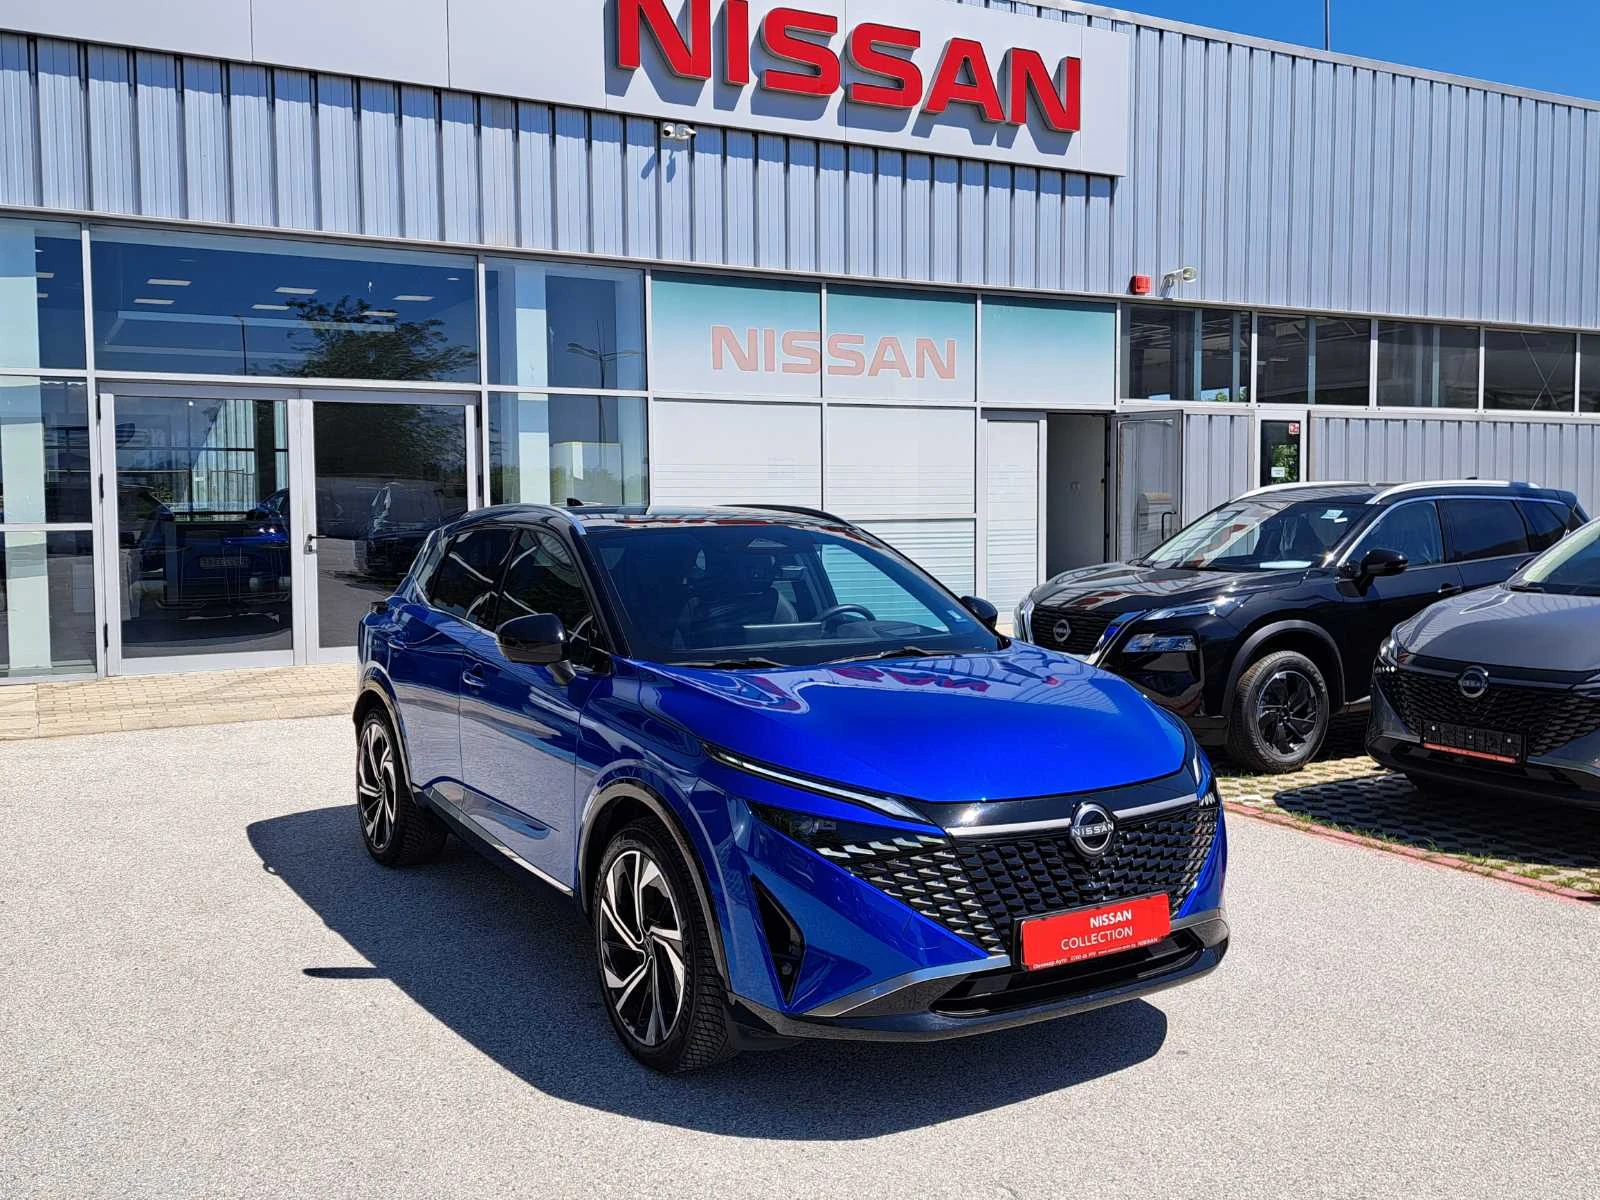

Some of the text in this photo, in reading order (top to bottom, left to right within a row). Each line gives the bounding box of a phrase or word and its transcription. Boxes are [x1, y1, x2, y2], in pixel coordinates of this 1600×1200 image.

[617, 0, 1081, 132] NISSAN
[710, 325, 957, 380] NISSAN
[1071, 821, 1114, 836] NISSAN
[1089, 908, 1132, 928] NISSAN
[1060, 926, 1133, 951] COLLECTION
